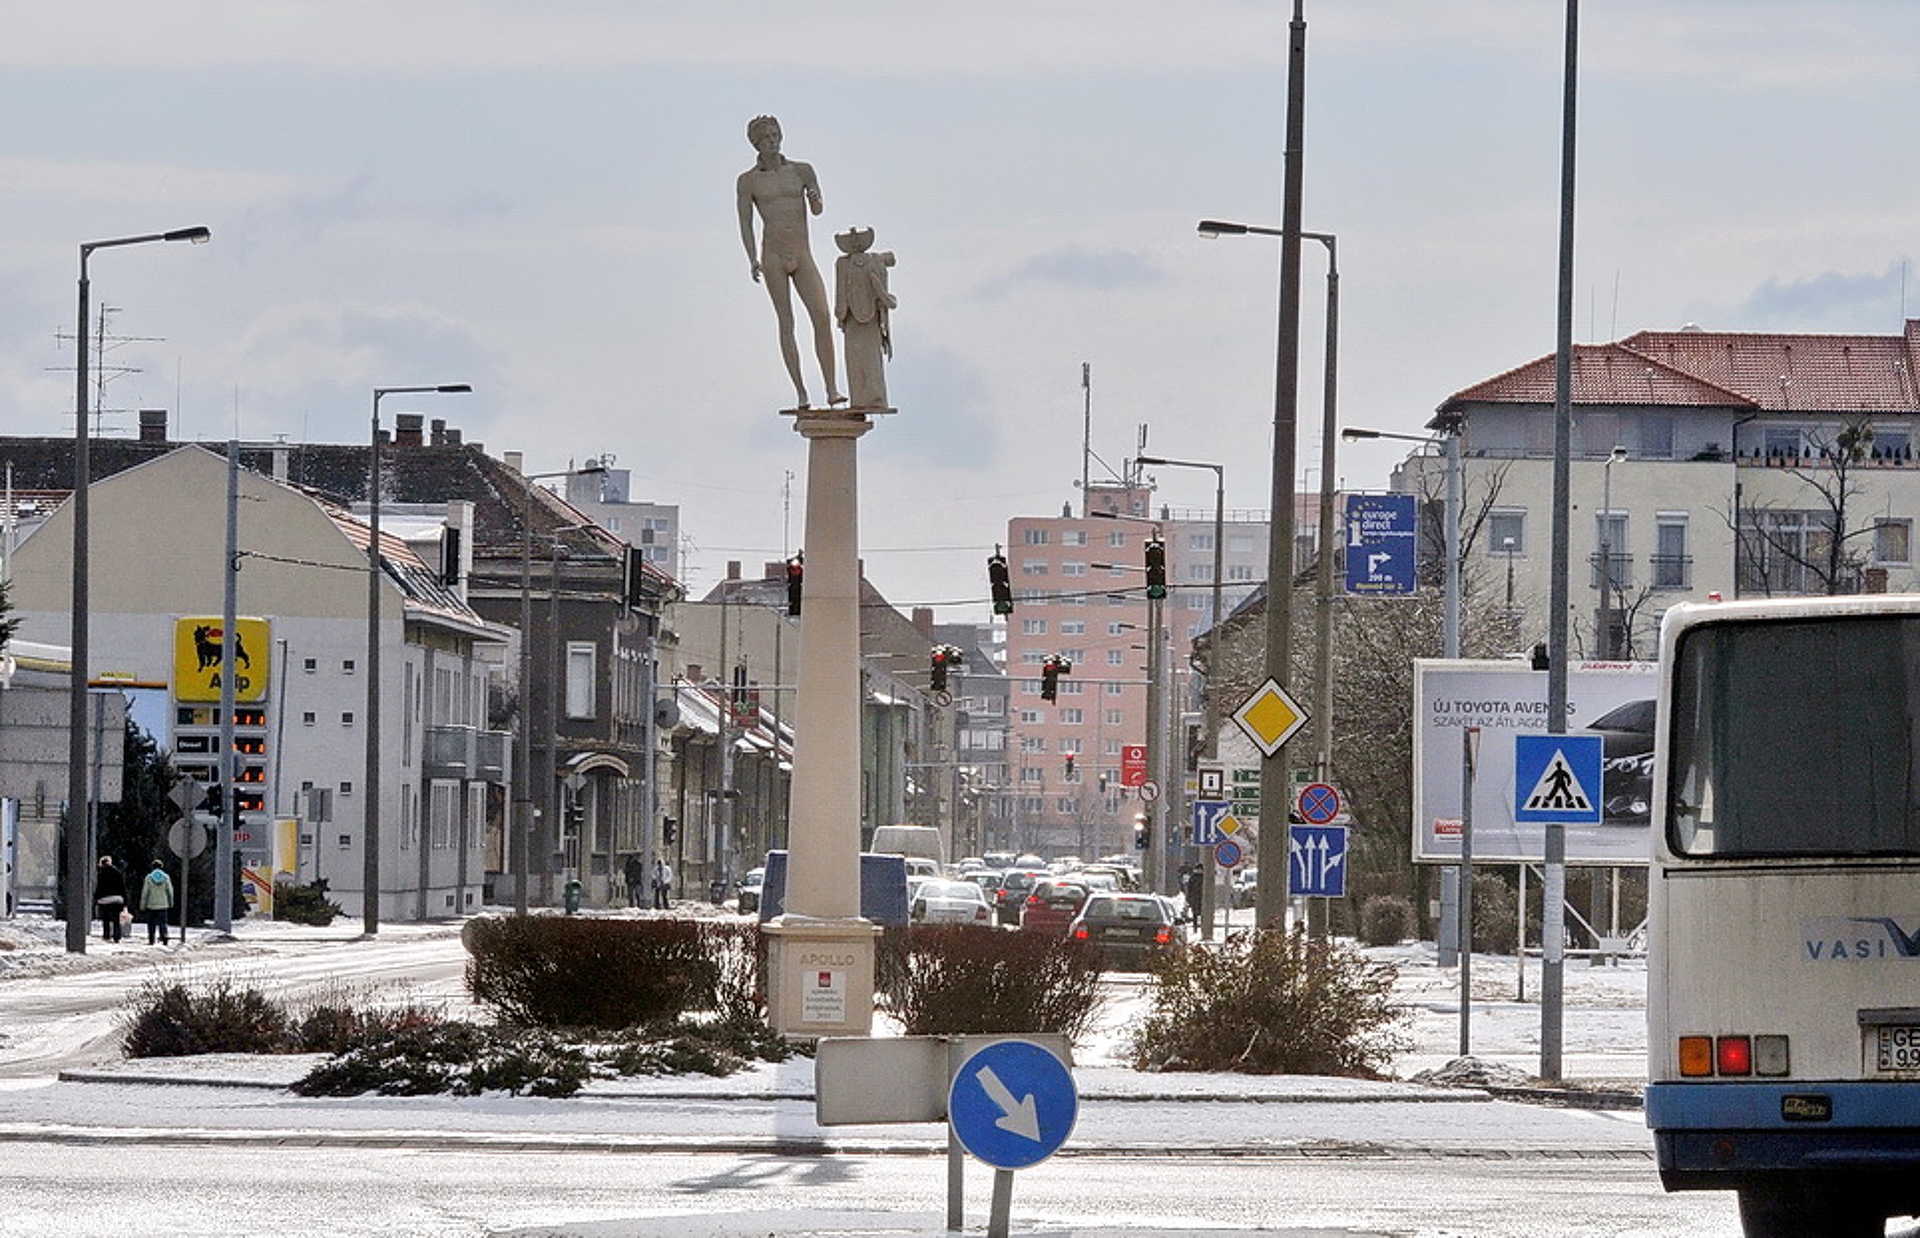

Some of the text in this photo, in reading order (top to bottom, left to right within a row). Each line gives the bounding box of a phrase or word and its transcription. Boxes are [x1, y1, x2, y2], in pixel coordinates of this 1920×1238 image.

[1362, 511, 1397, 521] europe
[1362, 519, 1391, 530] direct
[209, 672, 250, 693] Aip
[1433, 698, 1577, 715] ÚJ TOYOTA AVENS
[1806, 939, 1885, 959] VASI
[800, 953, 856, 966] APOLLO
